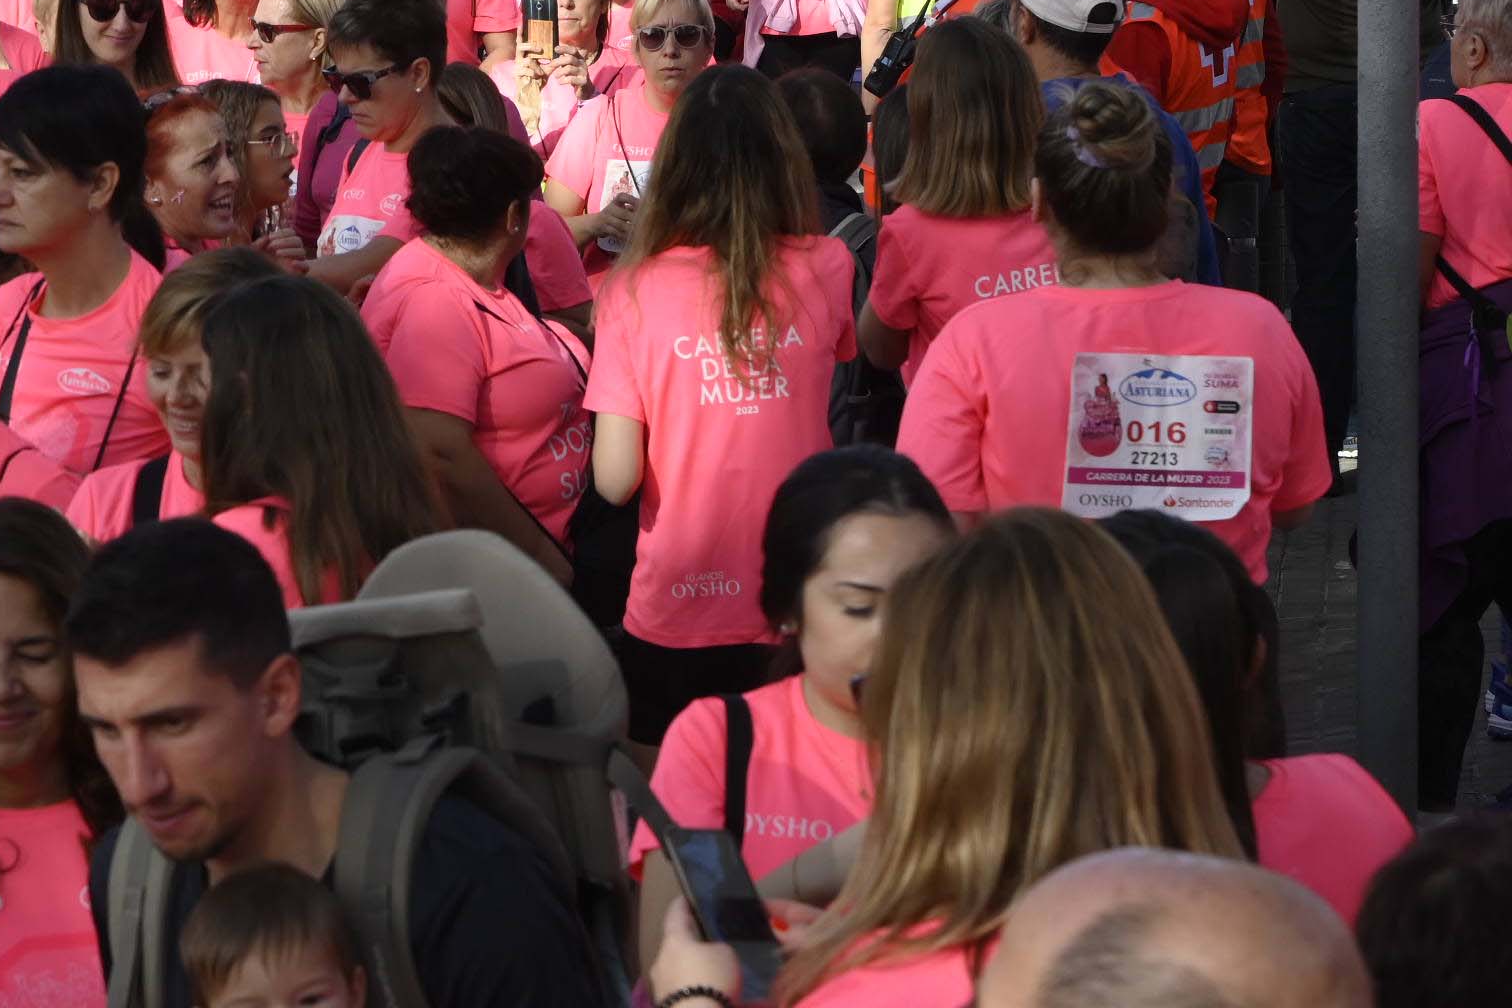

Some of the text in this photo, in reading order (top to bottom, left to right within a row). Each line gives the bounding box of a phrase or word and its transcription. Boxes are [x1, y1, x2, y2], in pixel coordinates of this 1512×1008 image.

[699, 375, 790, 406] MUJER
[1124, 382, 1190, 398] ASTURIANA
[735, 405, 760, 416] 2023
[1127, 420, 1187, 444] 016
[1131, 451, 1179, 466] 27213
[1086, 472, 1231, 485] CARRERA DE LA MUJER 2023
[1079, 494, 1133, 508] OYSHO
[1178, 496, 1235, 508] Santander
[671, 579, 741, 600] OYSHO
